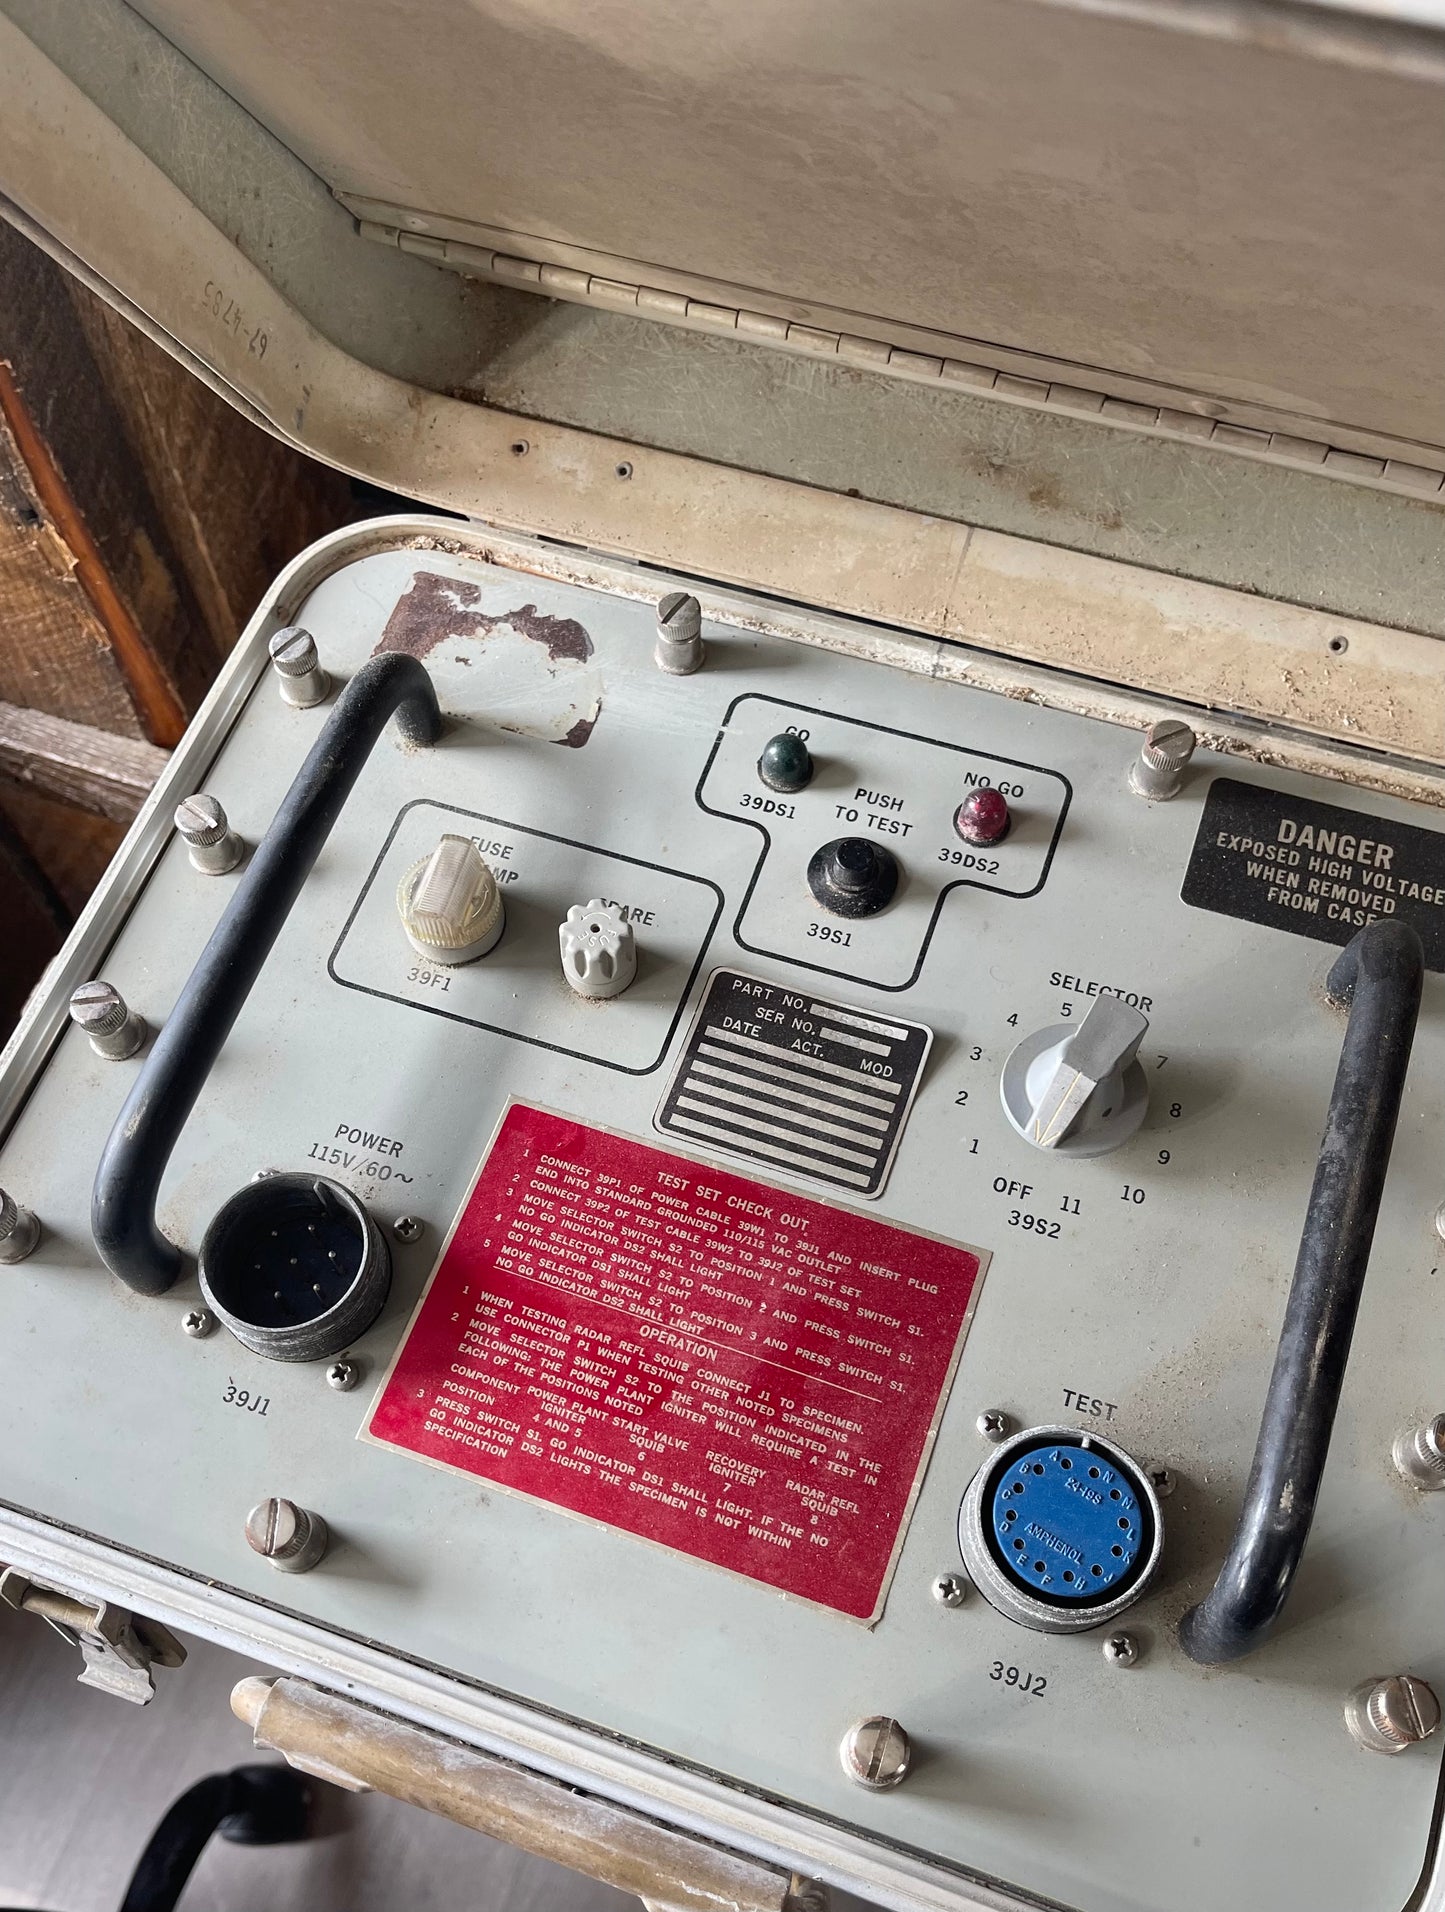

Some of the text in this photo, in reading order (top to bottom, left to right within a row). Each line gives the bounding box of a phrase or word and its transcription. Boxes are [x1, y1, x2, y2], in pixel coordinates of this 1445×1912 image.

[964, 772, 1023, 797] NO GO
[740, 793, 796, 820] 39DS1
[854, 787, 904, 813] PUSH
[835, 805, 913, 838] TO TEST
[1277, 819, 1394, 871] DANGER
[938, 847, 1000, 875] 39DS2
[1216, 831, 1445, 905] EXPOSED HIGH VOLTAGE
[1246, 861, 1396, 914] WHEN REMOVED
[1267, 887, 1320, 914] FROM
[806, 922, 852, 948] 39S1
[406, 967, 452, 992] 39F1
[732, 979, 808, 1013] PART NO.
[1060, 1002, 1072, 1017] 5
[722, 1016, 762, 1038] DATE
[755, 1007, 785, 1024] SER
[792, 1018, 816, 1036] NO.
[1006, 1012, 1019, 1028] 4
[791, 1039, 824, 1058] ACT.
[970, 1046, 982, 1061] 3
[1156, 1054, 1169, 1070] 7
[859, 1058, 893, 1078] MOD
[955, 1090, 968, 1106] 2
[1170, 1102, 1182, 1118] 8
[334, 1123, 404, 1158] POWER
[969, 1138, 979, 1154] 1
[1157, 1150, 1170, 1165] 9
[657, 1171, 811, 1232] TEST SET CHECK OUT
[992, 1176, 1034, 1200] OFF
[1120, 1184, 1146, 1204] 10
[535, 1165, 842, 1274] END INTO STANDARD GROUNDED 110/115 VAC OUTLET
[1060, 1195, 1081, 1215] 11
[512, 1173, 863, 1298] 2 CONNECT 39P2 OF TEST CABLE 39W2 TO 39J2 OF TEST SET
[522, 1148, 939, 1295] 1 CONNECT 39P1 OF POWER CABLE 39W1 TO 39J1 AND INSERT PLUG
[1008, 1210, 1062, 1239] 39S2
[518, 1204, 724, 1281] NO GO INDICATOR DS2 SHALL LIGHT
[505, 1187, 924, 1337] 3 MOVE SELECTOR SWITCH S2 TO POSITION 1 AND PRESS SWITCH S1.
[638, 1324, 718, 1362] OPERATION
[462, 1285, 864, 1435] 1 WHEN TESTING RADAR REFL SQUIB CONNECT J1 TO SPECIMEN.
[475, 1303, 848, 1443] USE CONNECTOR P1 WHEN TESTING OTHER NOTED SPECIMENS
[450, 1363, 521, 1395] COMPONENT
[222, 1385, 271, 1416] 39J1
[1062, 1388, 1118, 1422] TEST
[423, 1420, 508, 1459] SPECIFICATION
[415, 1388, 830, 1547] 3 PRESS SWITCH S1. GO INDICATOR DS1 SHALL LIGHT. IF THE NO
[705, 1450, 767, 1479] RECOVERY
[785, 1479, 860, 1515] RADAR REFL
[1024, 1522, 1084, 1565] AMPHENOL
[989, 1660, 1048, 1698] 39J2
